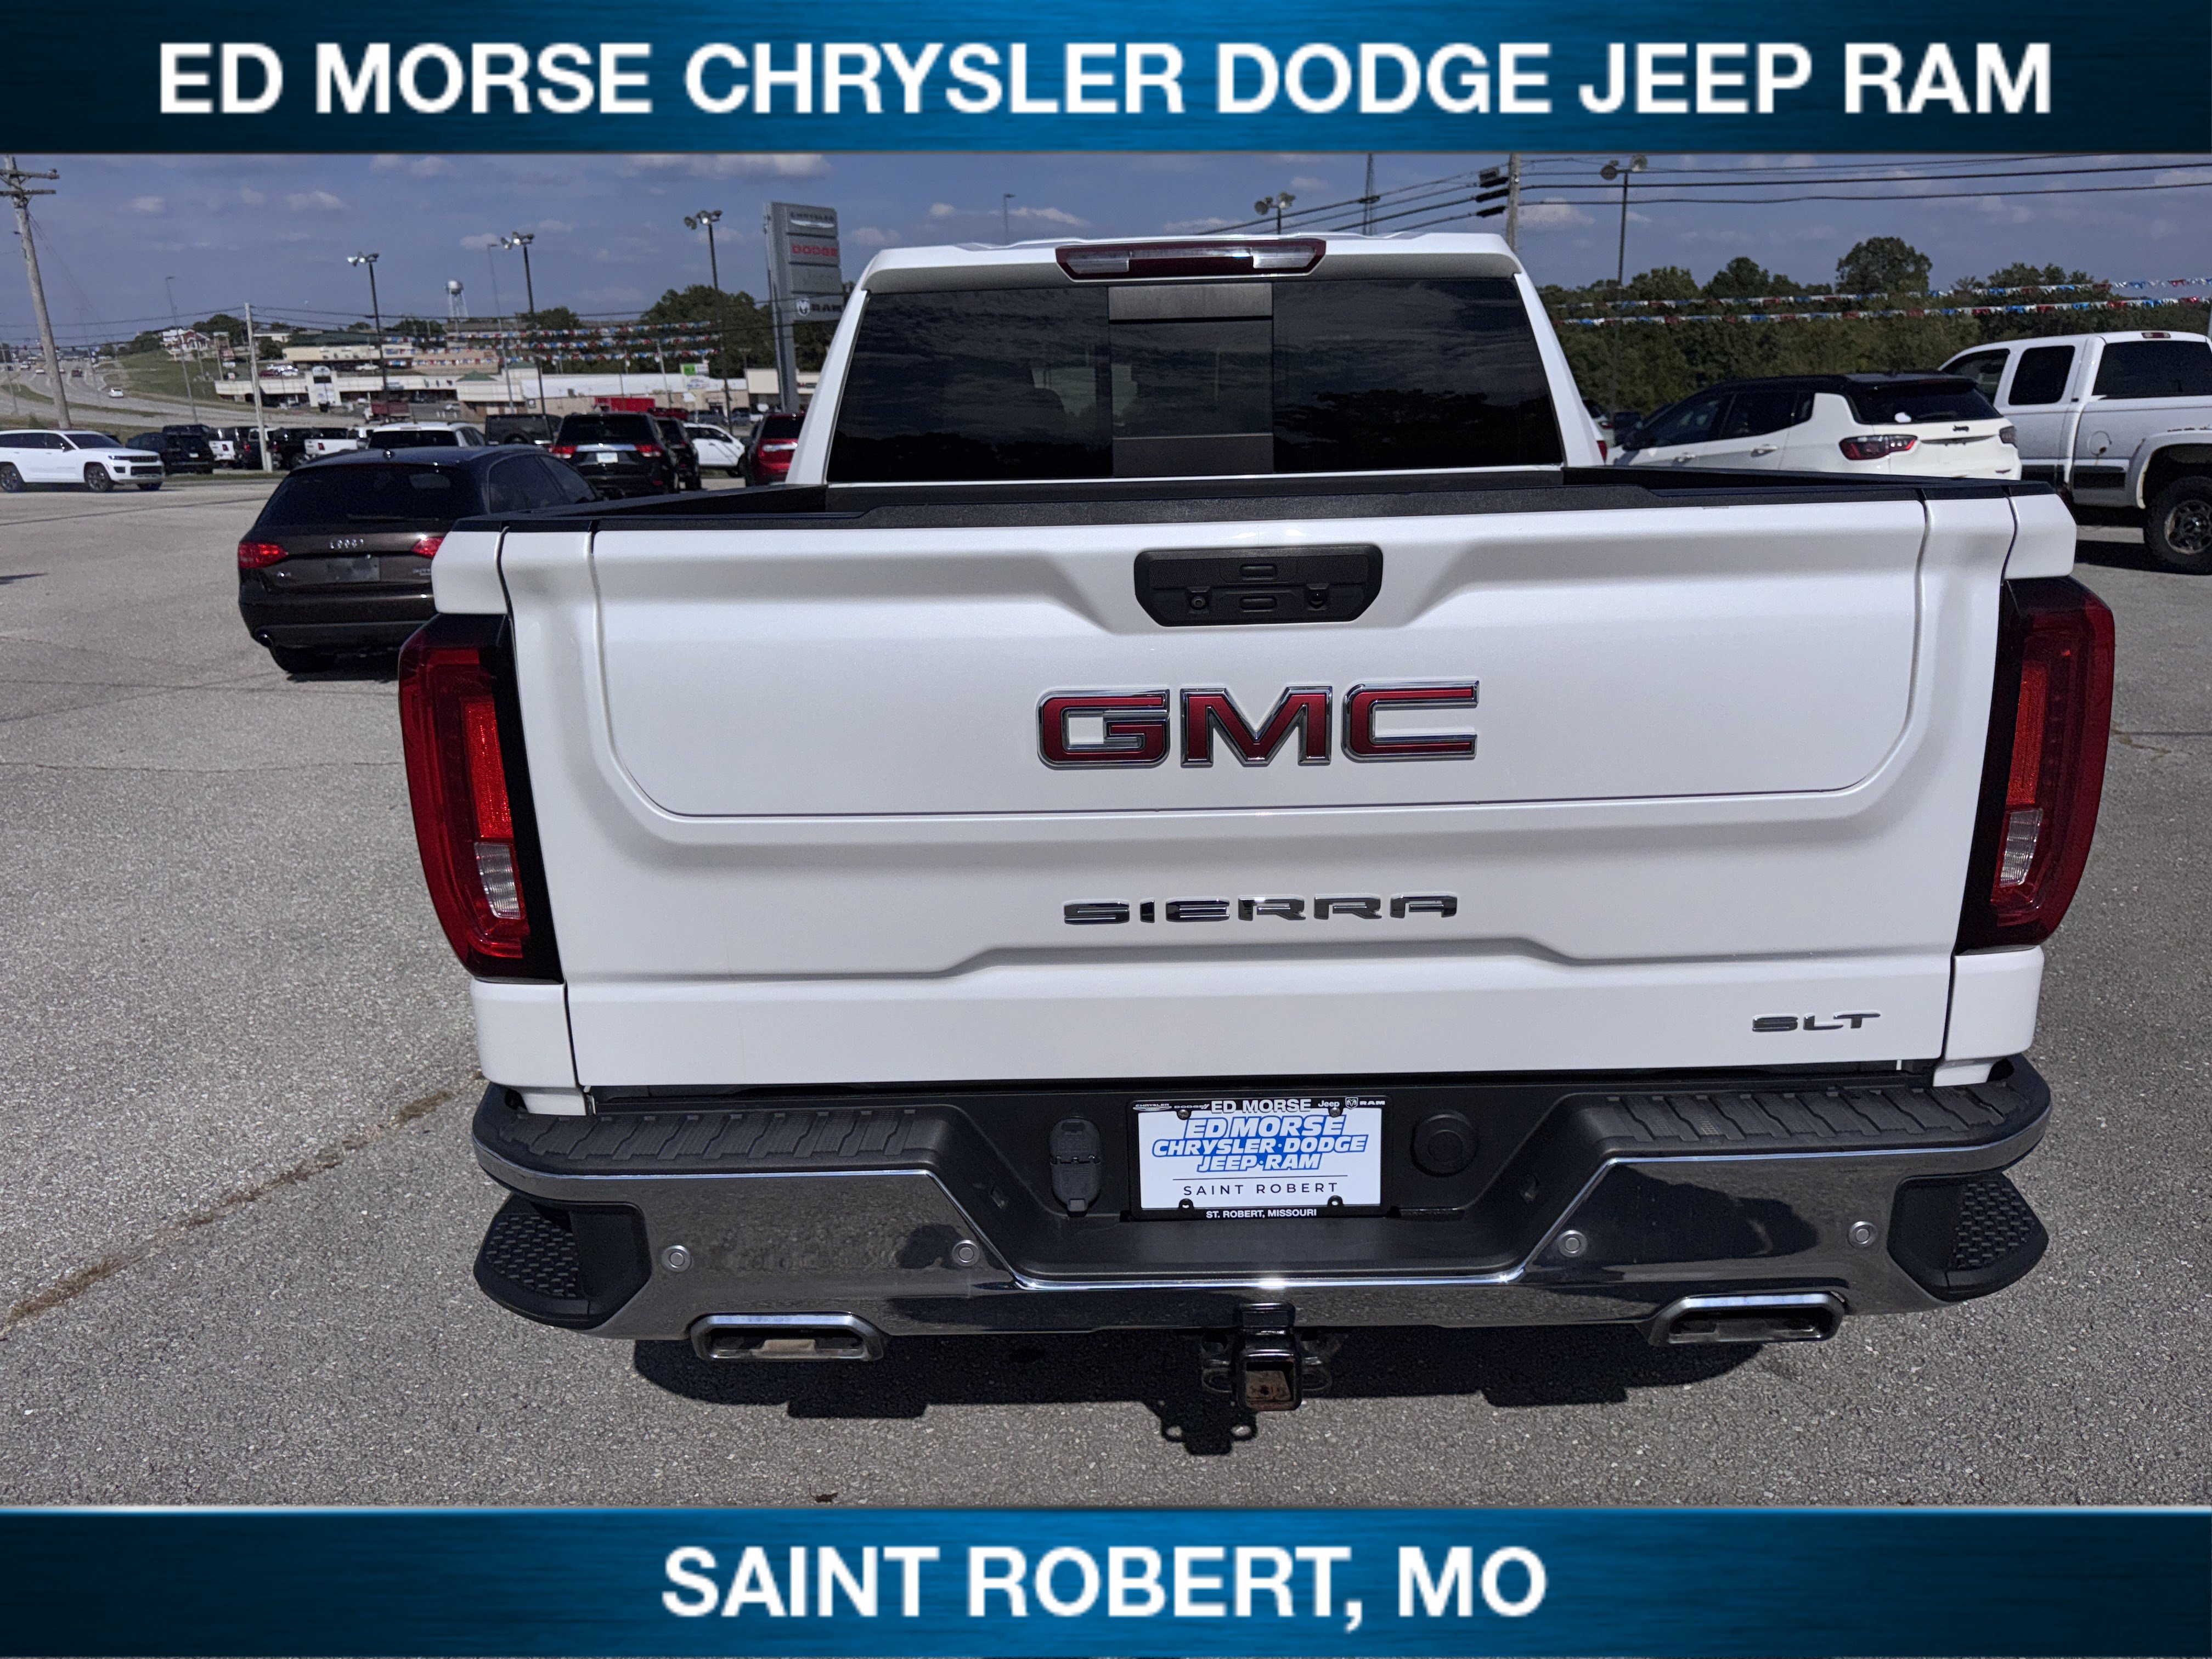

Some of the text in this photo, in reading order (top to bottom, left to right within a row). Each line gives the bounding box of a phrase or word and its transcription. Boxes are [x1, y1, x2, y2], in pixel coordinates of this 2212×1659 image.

[792, 244, 838, 257] DODGE
[1036, 680, 1480, 769] GMC
[1063, 894, 1458, 924] SIERRA
[1752, 1009, 1881, 1032] SLT
[1211, 1098, 1312, 1114] ED MORSE
[1184, 1115, 1346, 1139] ED MORSE
[1183, 1182, 1338, 1195] SAINT ROBERT
[1205, 1208, 1317, 1219] ST. ROBERT, MISSOURI
